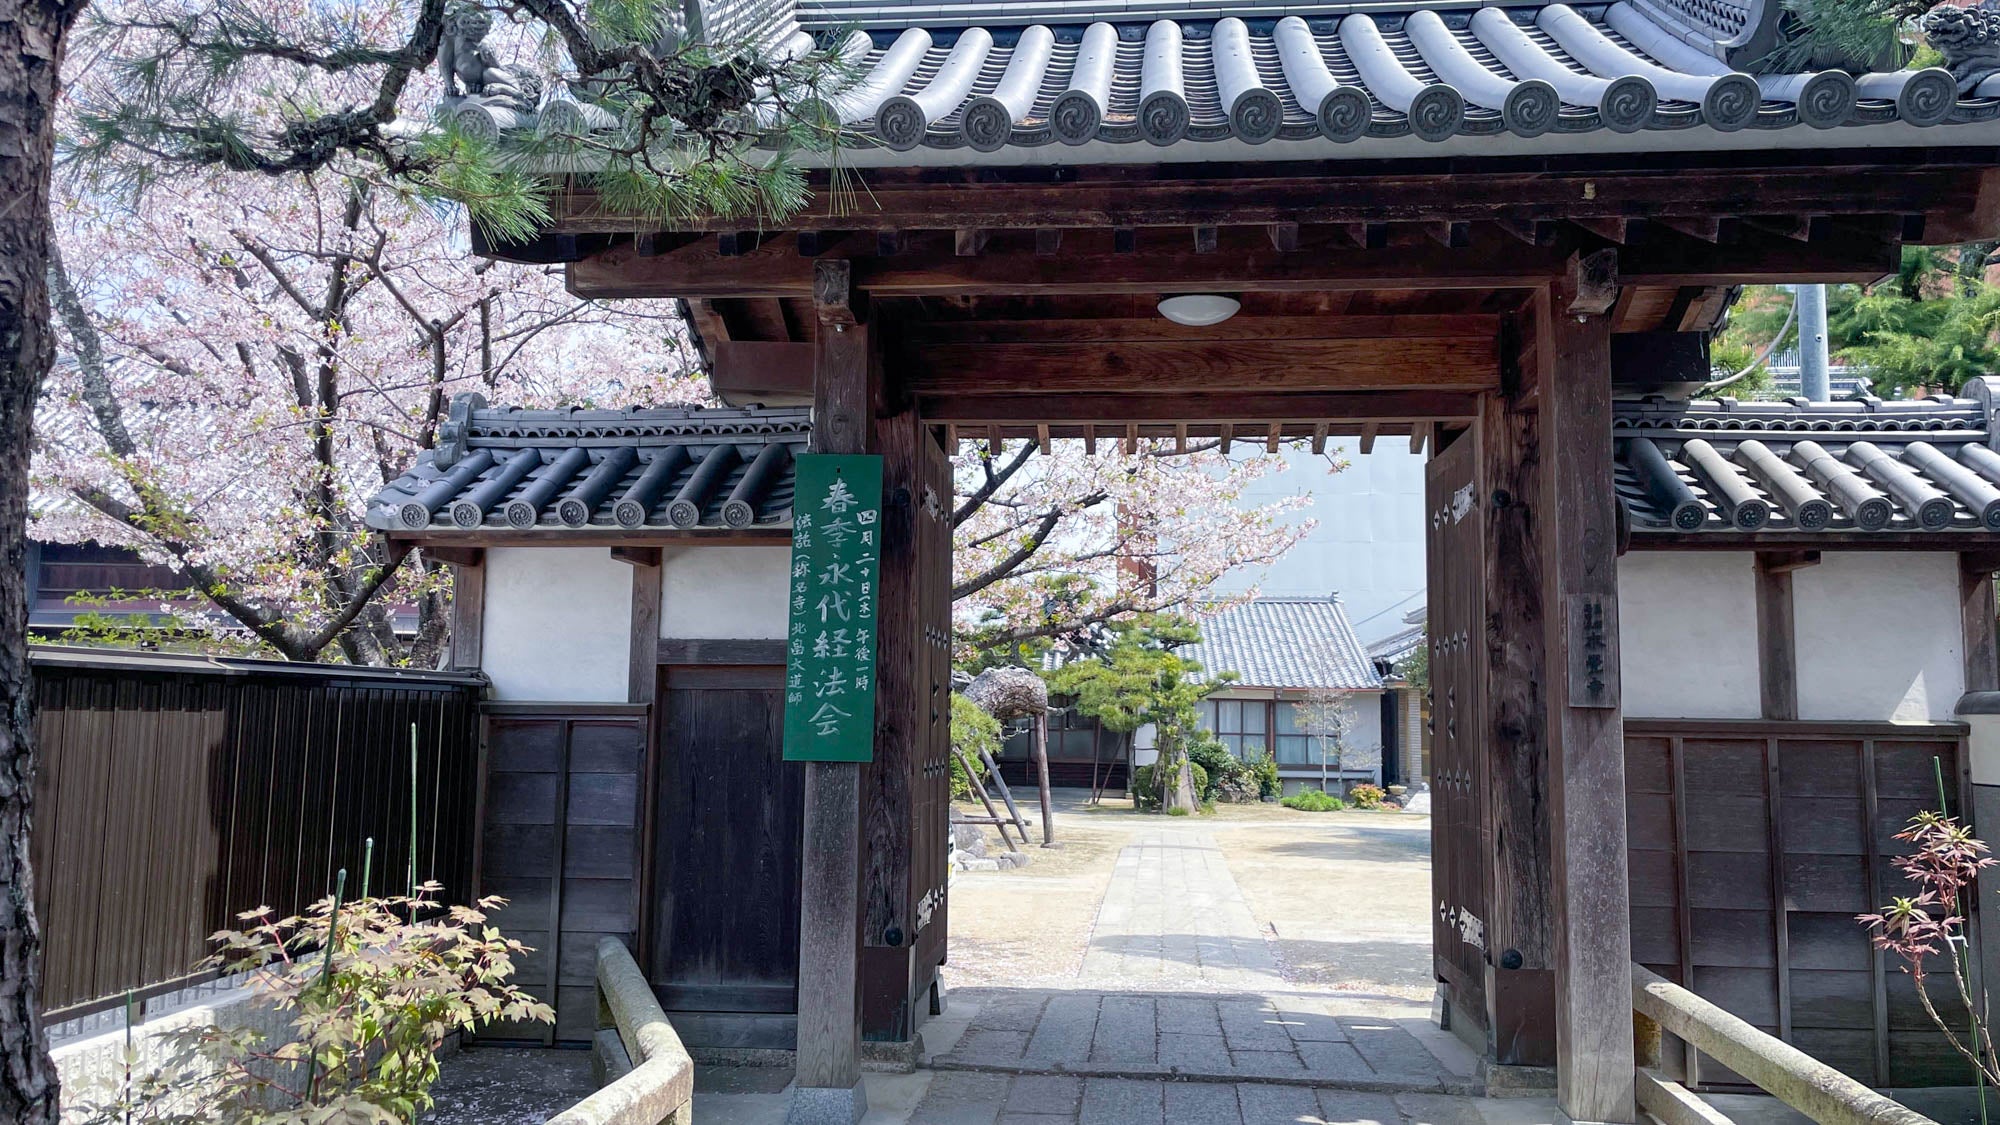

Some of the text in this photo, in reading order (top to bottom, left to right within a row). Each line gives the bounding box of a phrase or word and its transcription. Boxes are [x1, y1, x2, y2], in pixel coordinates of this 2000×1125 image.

[808, 477, 859, 737] 春季永代経法会
